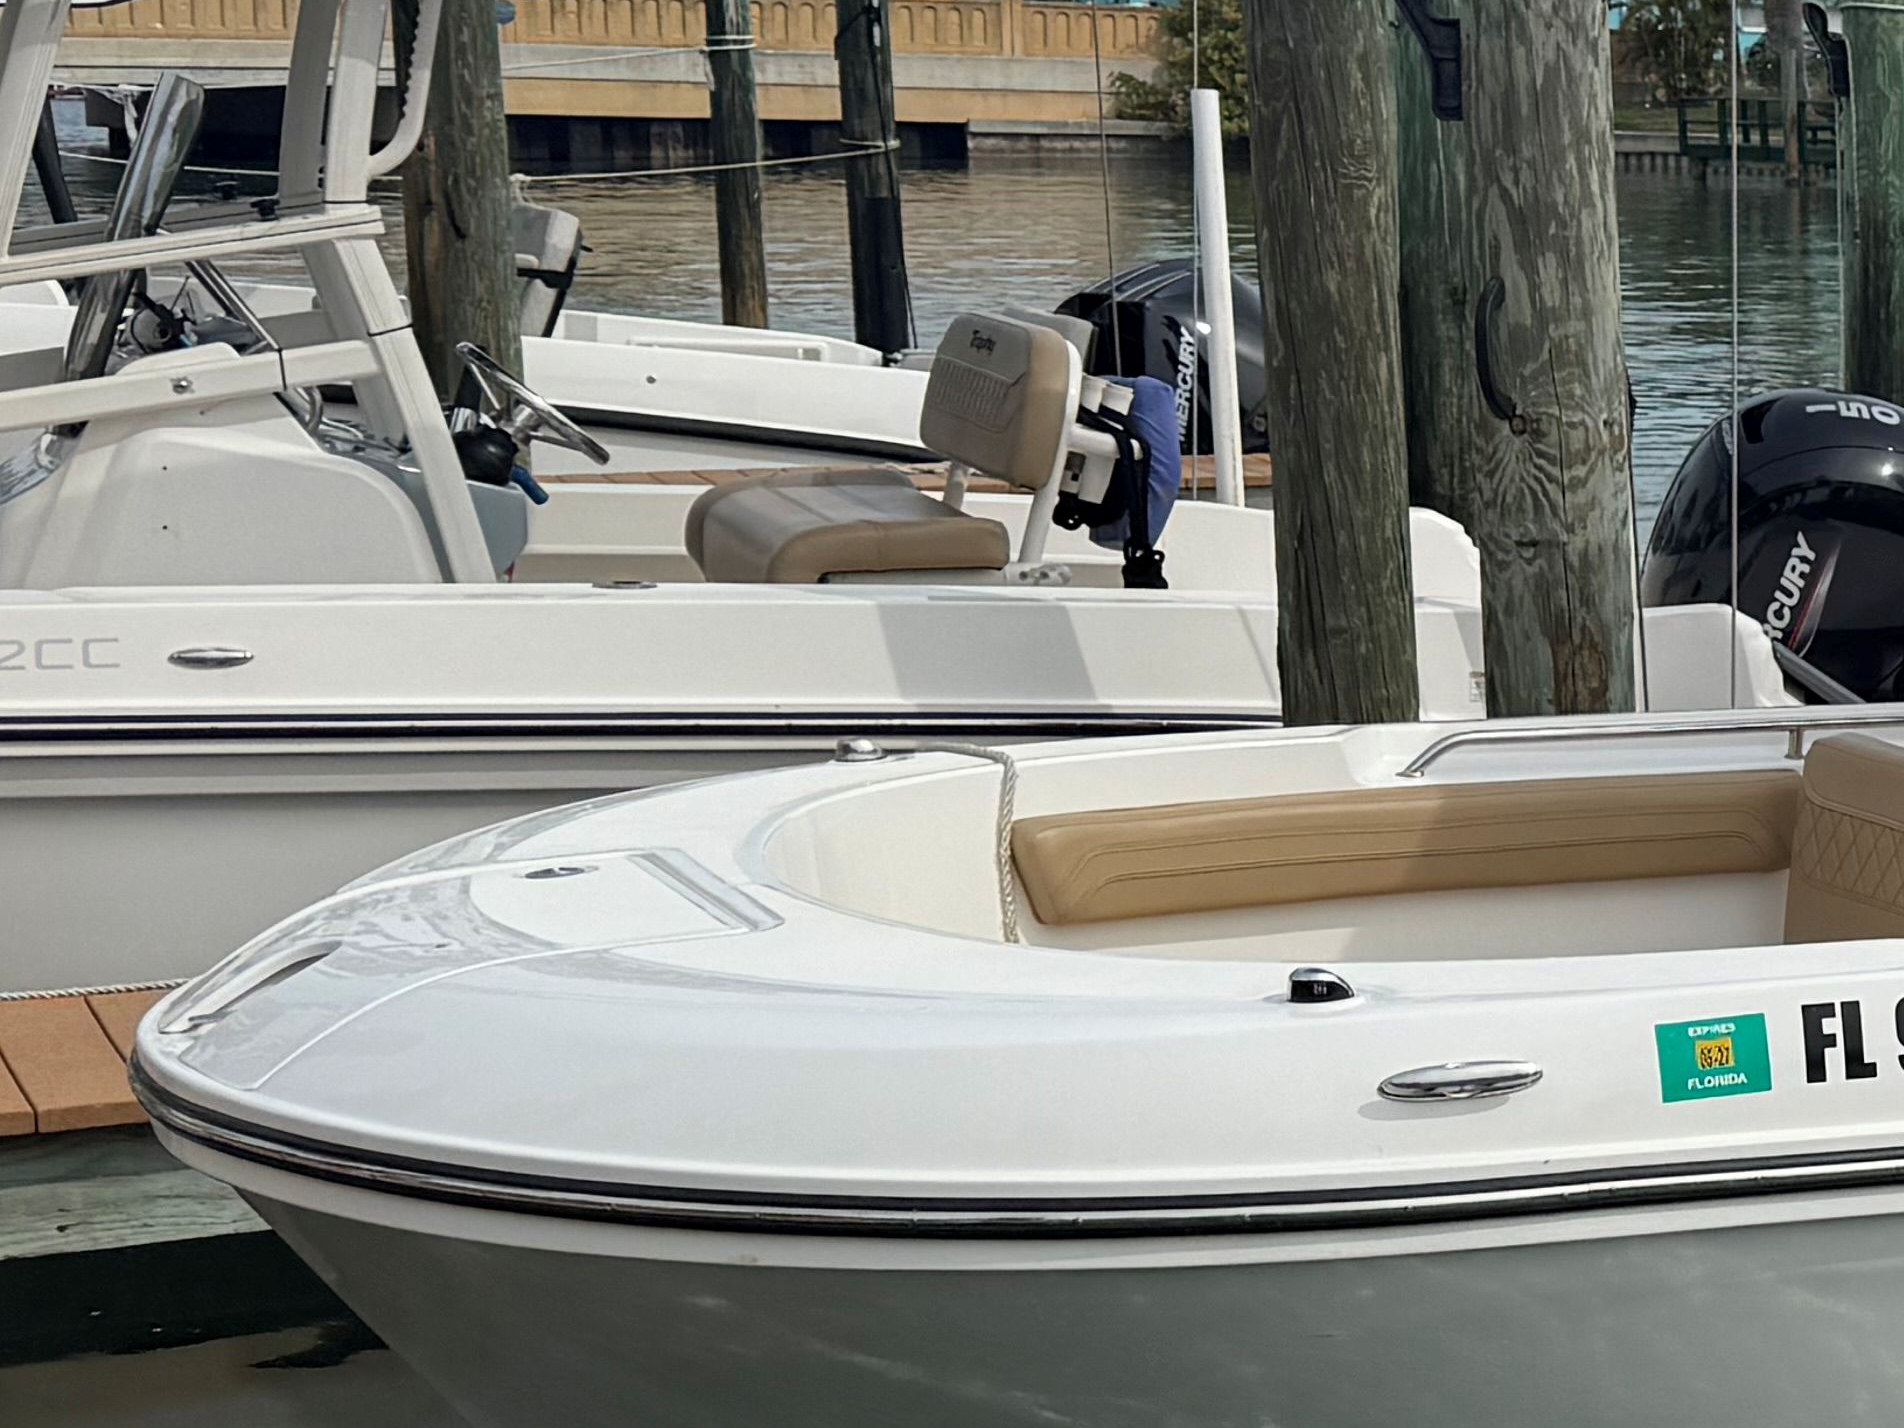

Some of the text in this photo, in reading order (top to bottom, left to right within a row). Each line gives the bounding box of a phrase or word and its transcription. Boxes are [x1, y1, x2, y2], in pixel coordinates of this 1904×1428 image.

[1805, 400, 1901, 426] 150
[1800, 999, 1880, 1084] FL
[1687, 1072, 1748, 1090] FLORIDA
